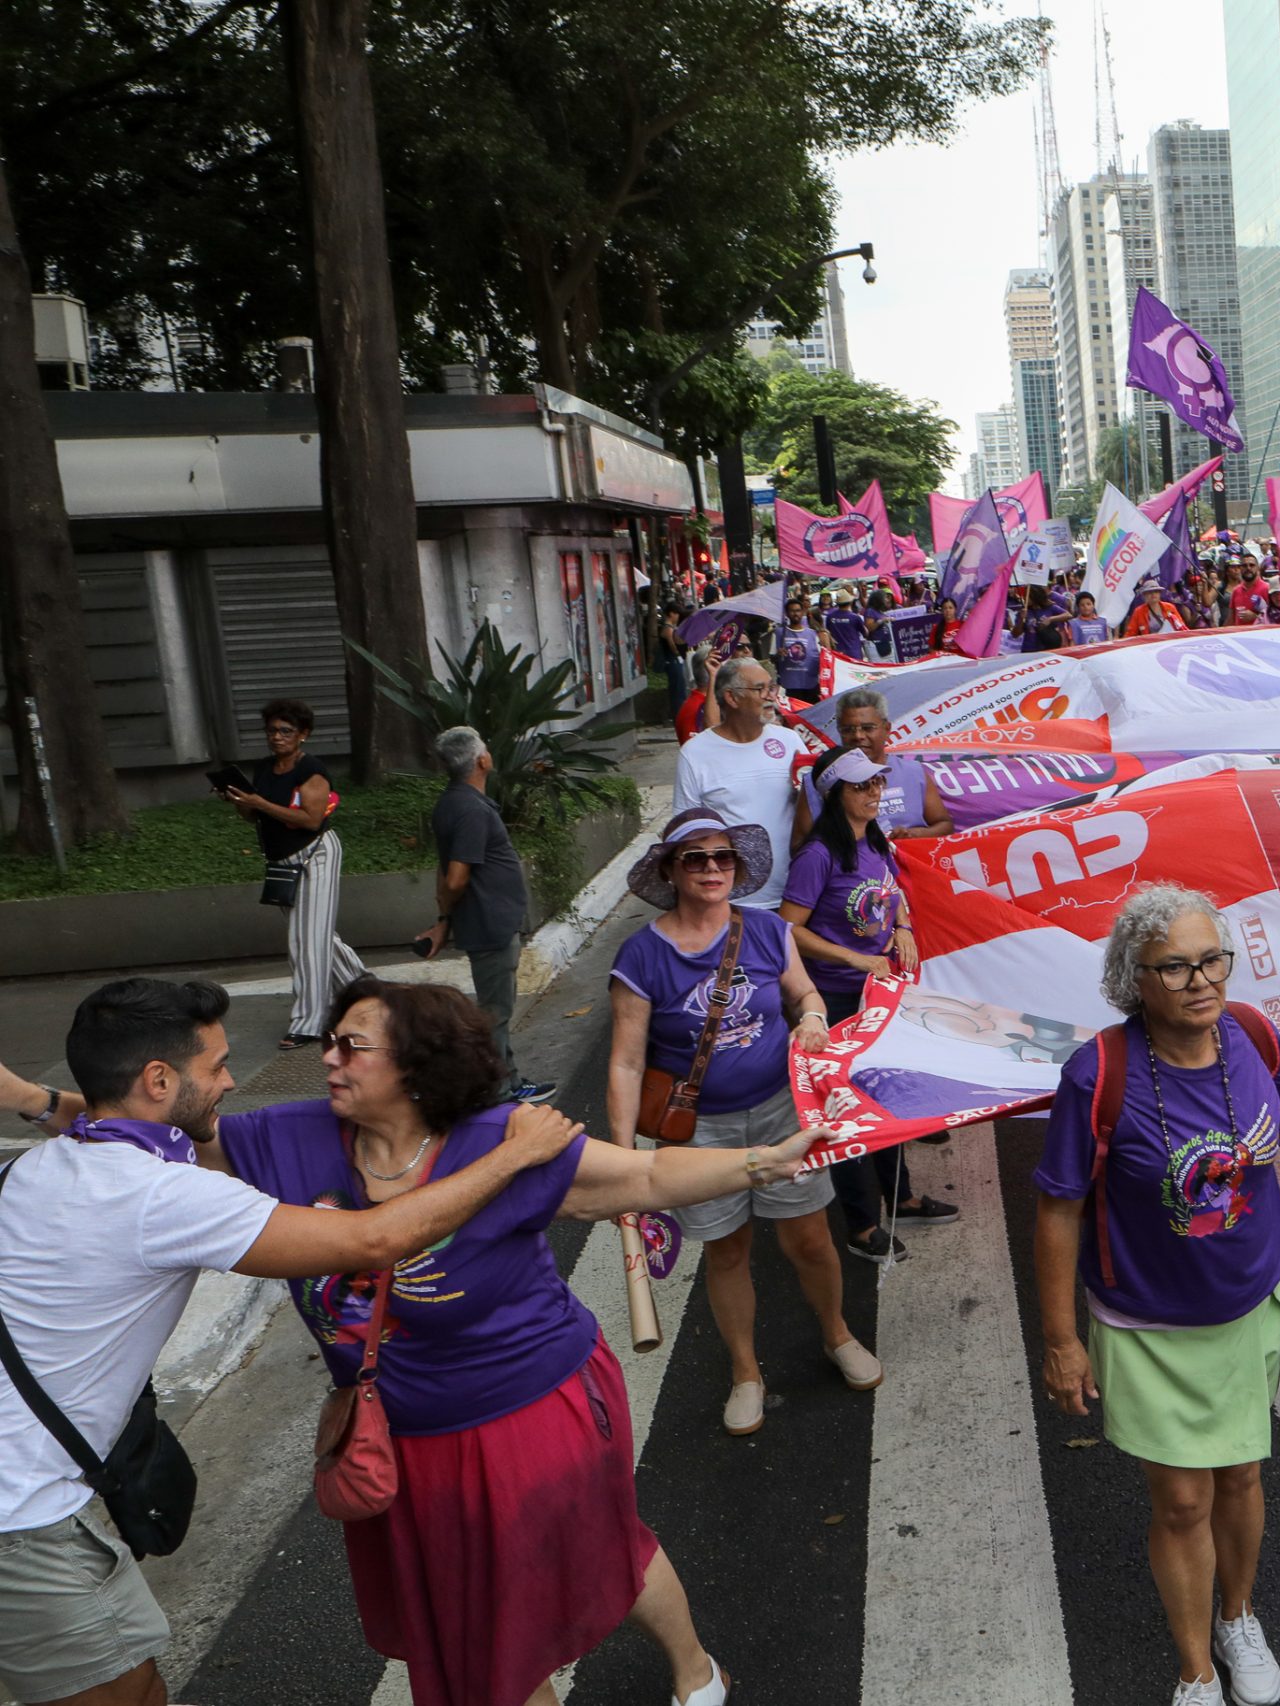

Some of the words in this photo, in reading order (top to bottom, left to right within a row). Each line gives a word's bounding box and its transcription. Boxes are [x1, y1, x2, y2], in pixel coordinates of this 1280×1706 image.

[1104, 539, 1142, 593] SECOR
[928, 658, 1062, 715] DEMOCRACIA
[884, 724, 912, 747] LU
[913, 714, 928, 728] E
[921, 753, 1104, 796] MULHER
[950, 811, 1149, 899] CUT
[1242, 918, 1275, 977] CUT
[1204, 1144, 1221, 1154] luta
